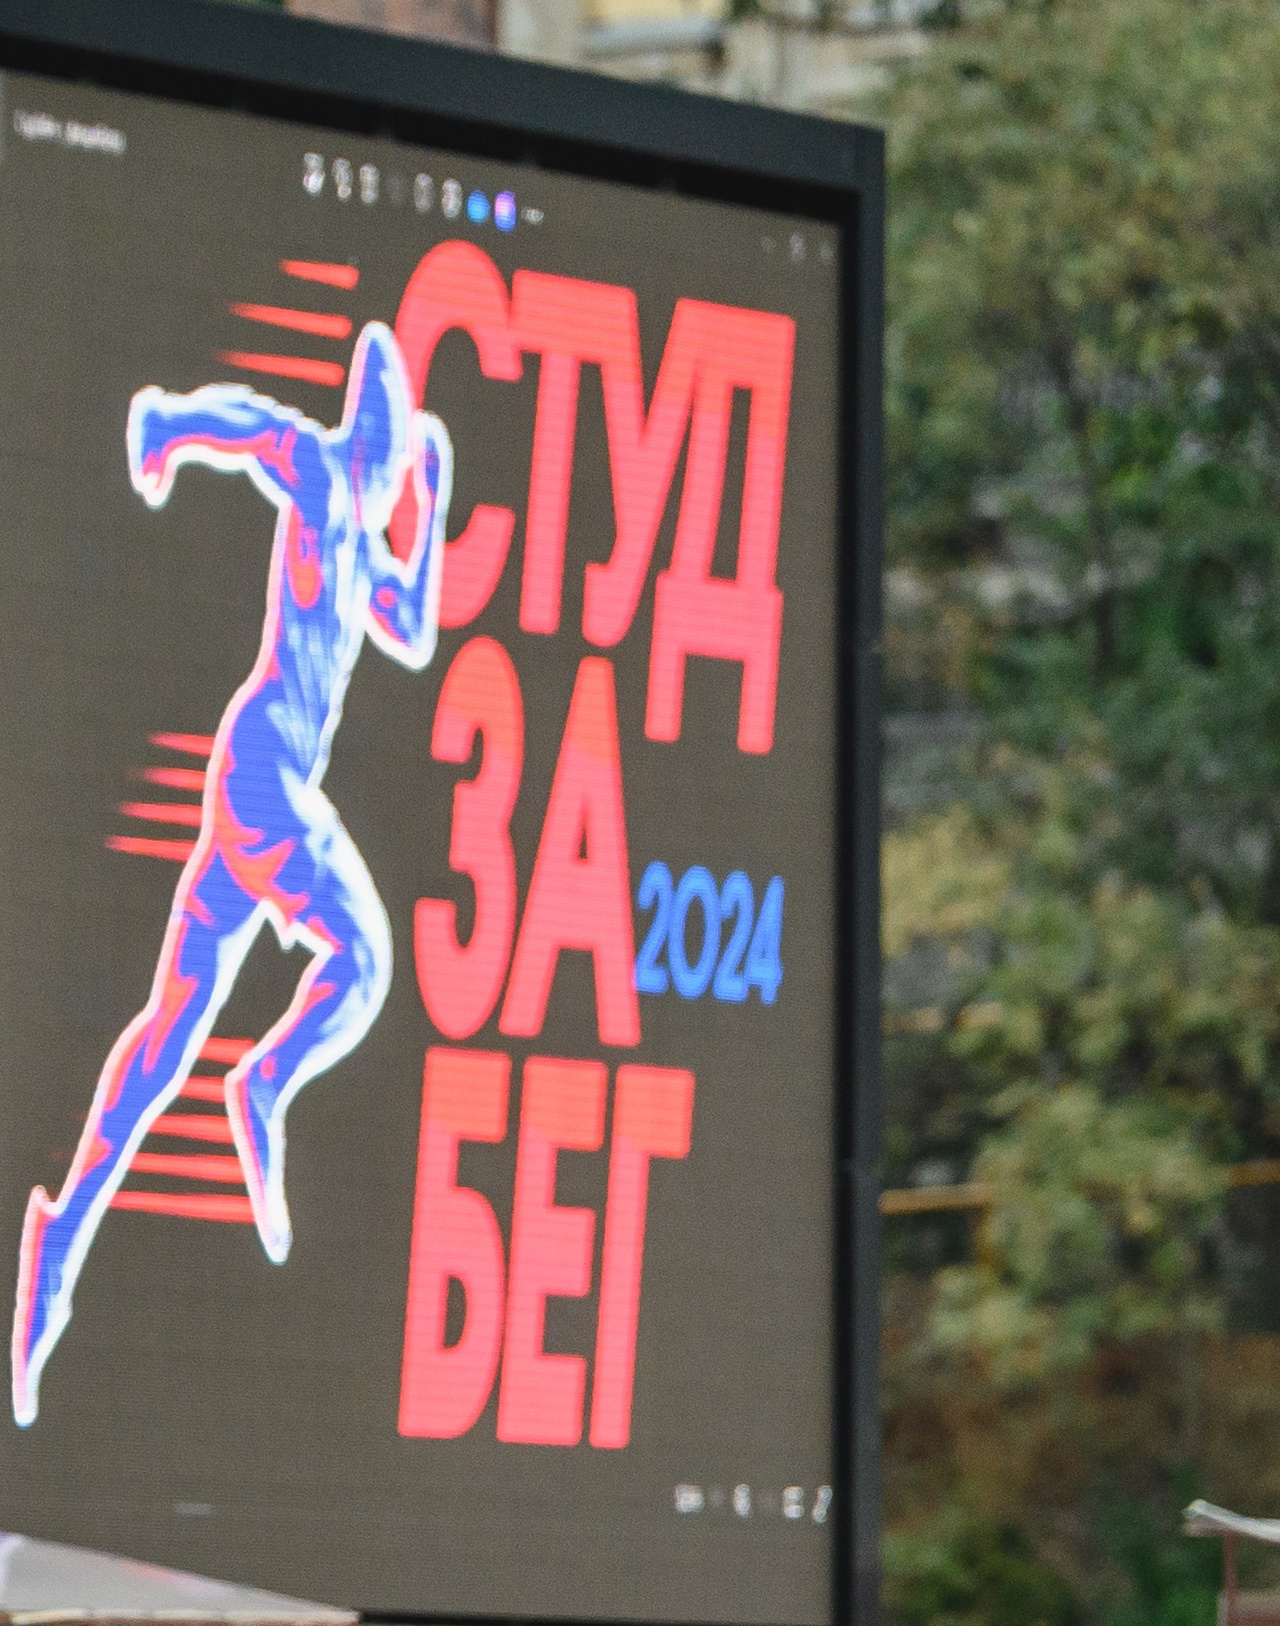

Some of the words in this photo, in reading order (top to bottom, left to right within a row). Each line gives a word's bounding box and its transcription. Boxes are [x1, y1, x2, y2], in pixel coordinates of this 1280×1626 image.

[387, 239, 797, 756] СТУД
[413, 634, 643, 1048] ЗА
[633, 860, 786, 1007] 2024
[396, 1046, 696, 1450] БЕГ
